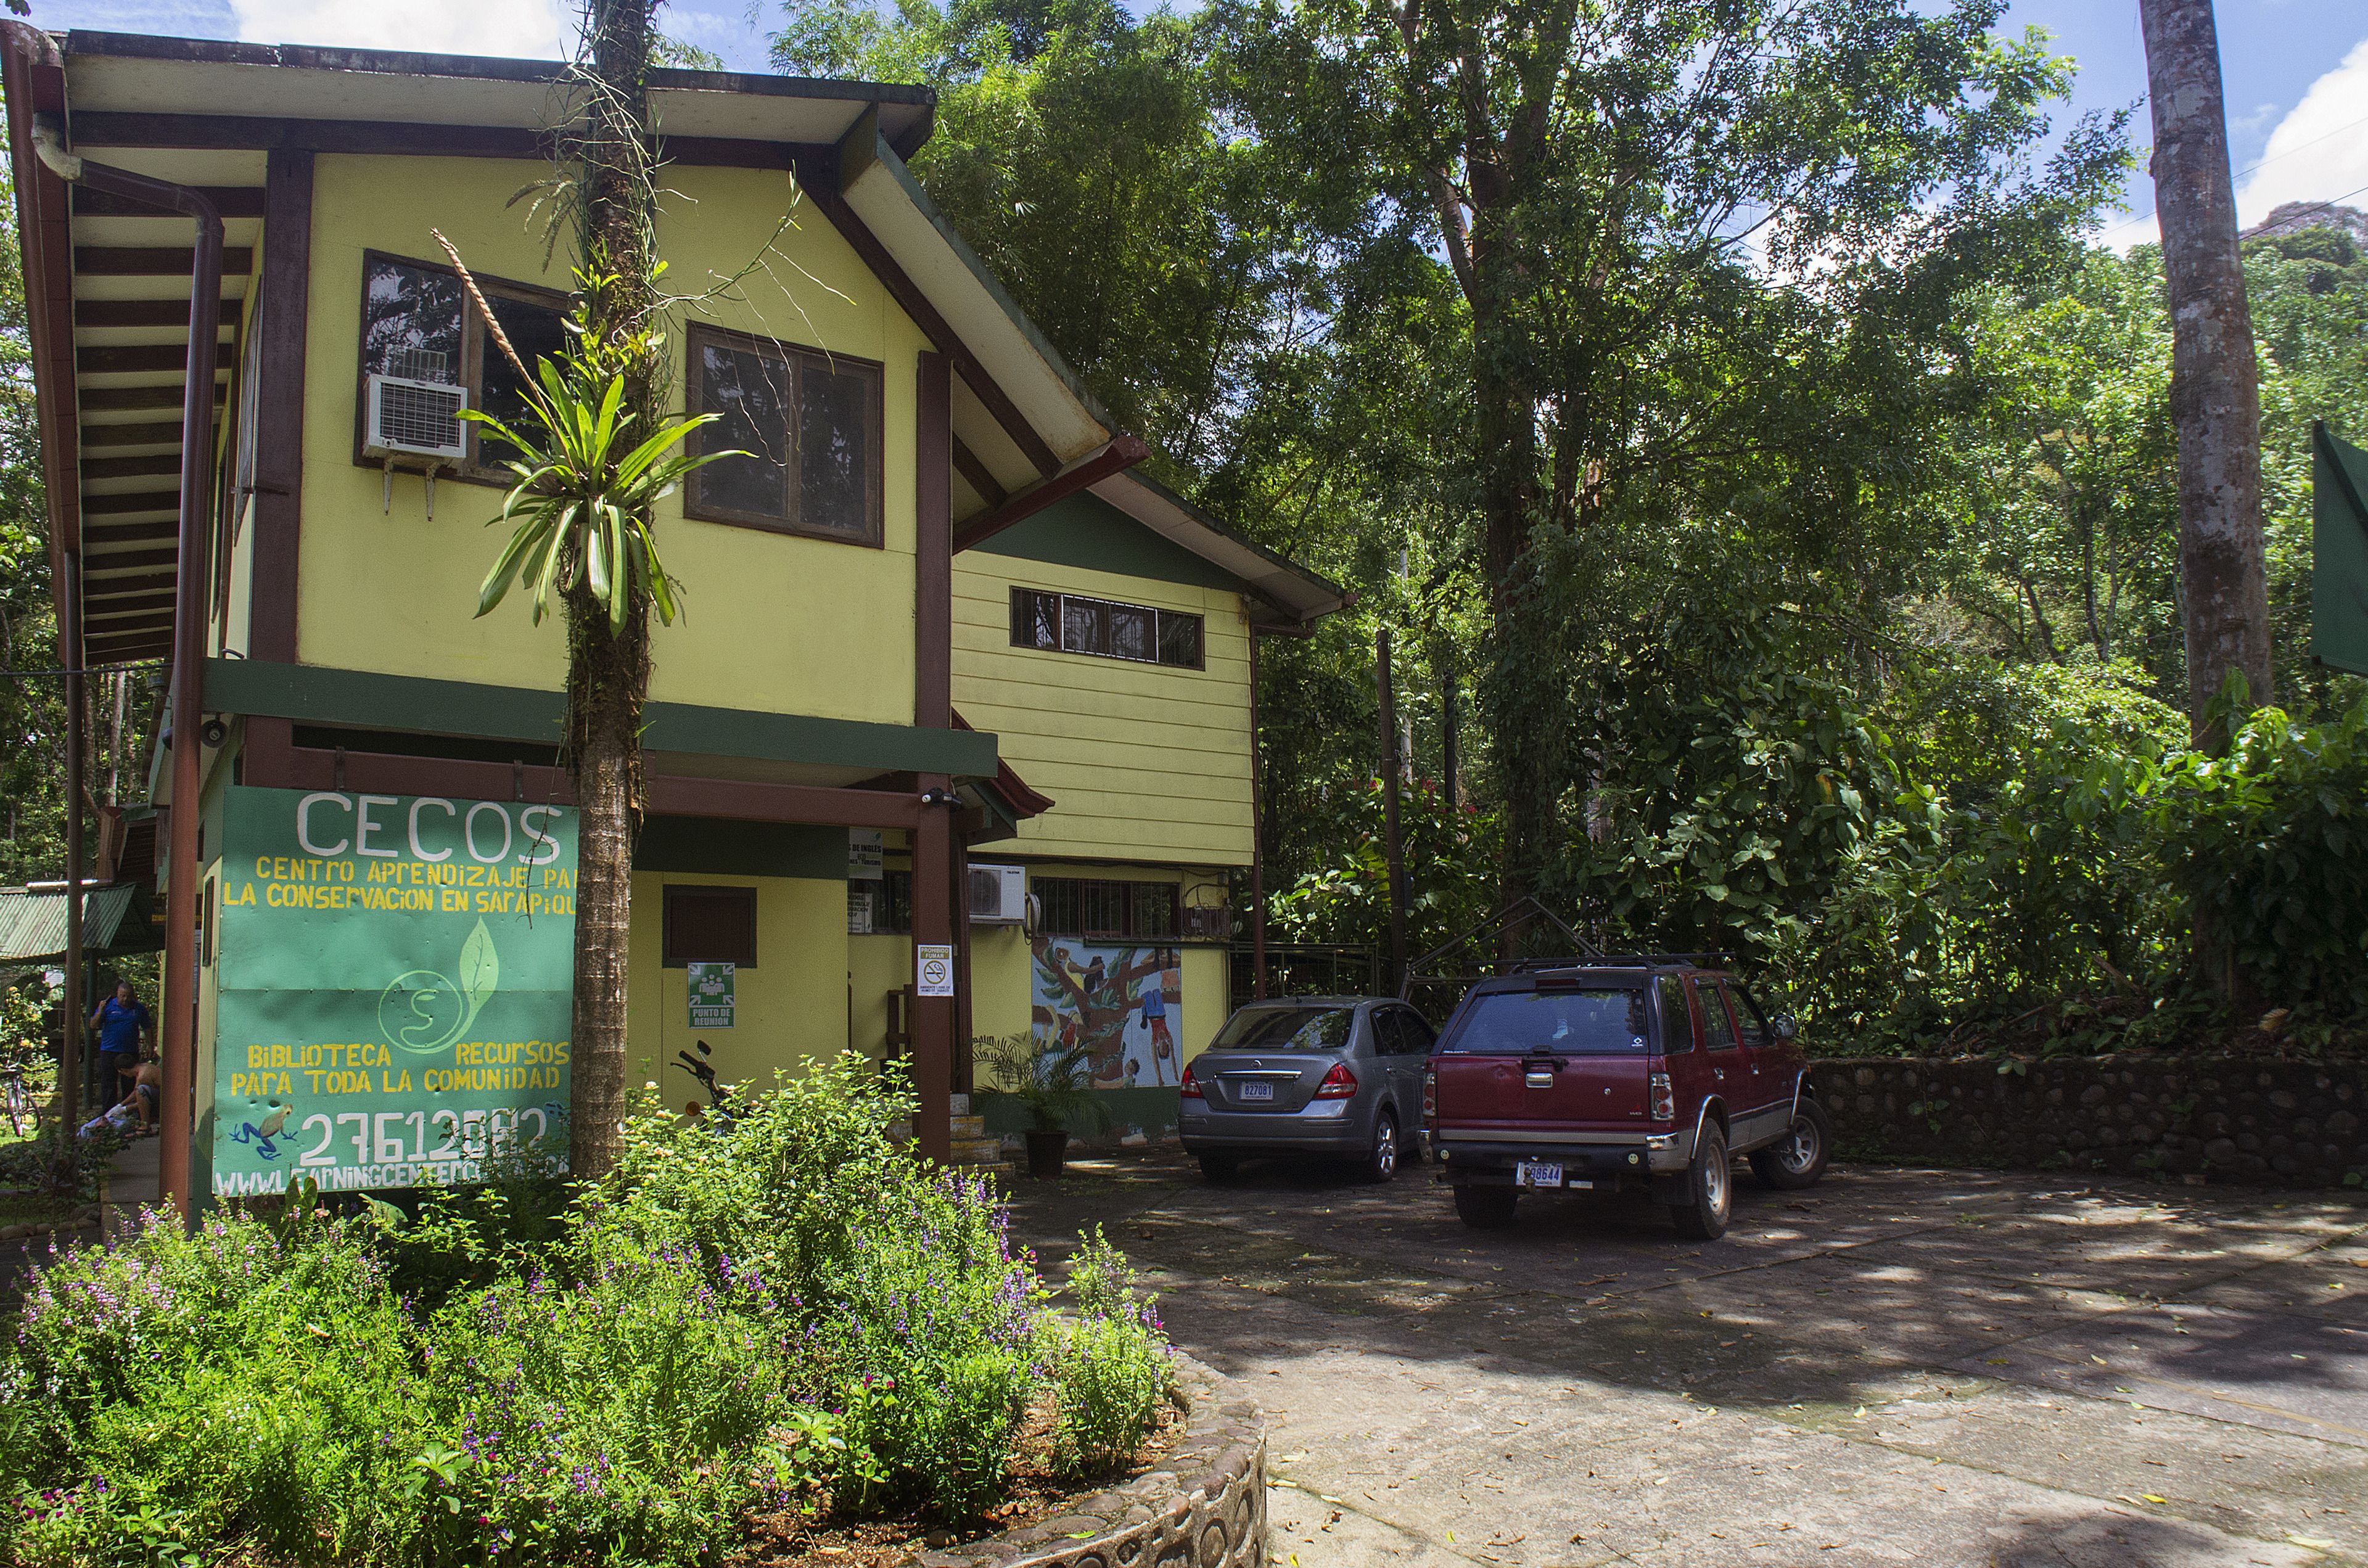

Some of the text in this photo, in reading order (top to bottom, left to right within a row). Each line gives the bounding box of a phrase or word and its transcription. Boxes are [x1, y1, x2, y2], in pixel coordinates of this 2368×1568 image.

[297, 792, 562, 865] CECOS
[223, 882, 257, 906] LA
[441, 889, 469, 912] EN
[693, 1009, 730, 1017] PUNTO DE
[303, 1069, 372, 1094] TODA
[382, 1069, 413, 1093] LA
[1245, 1085, 1271, 1095] 827081
